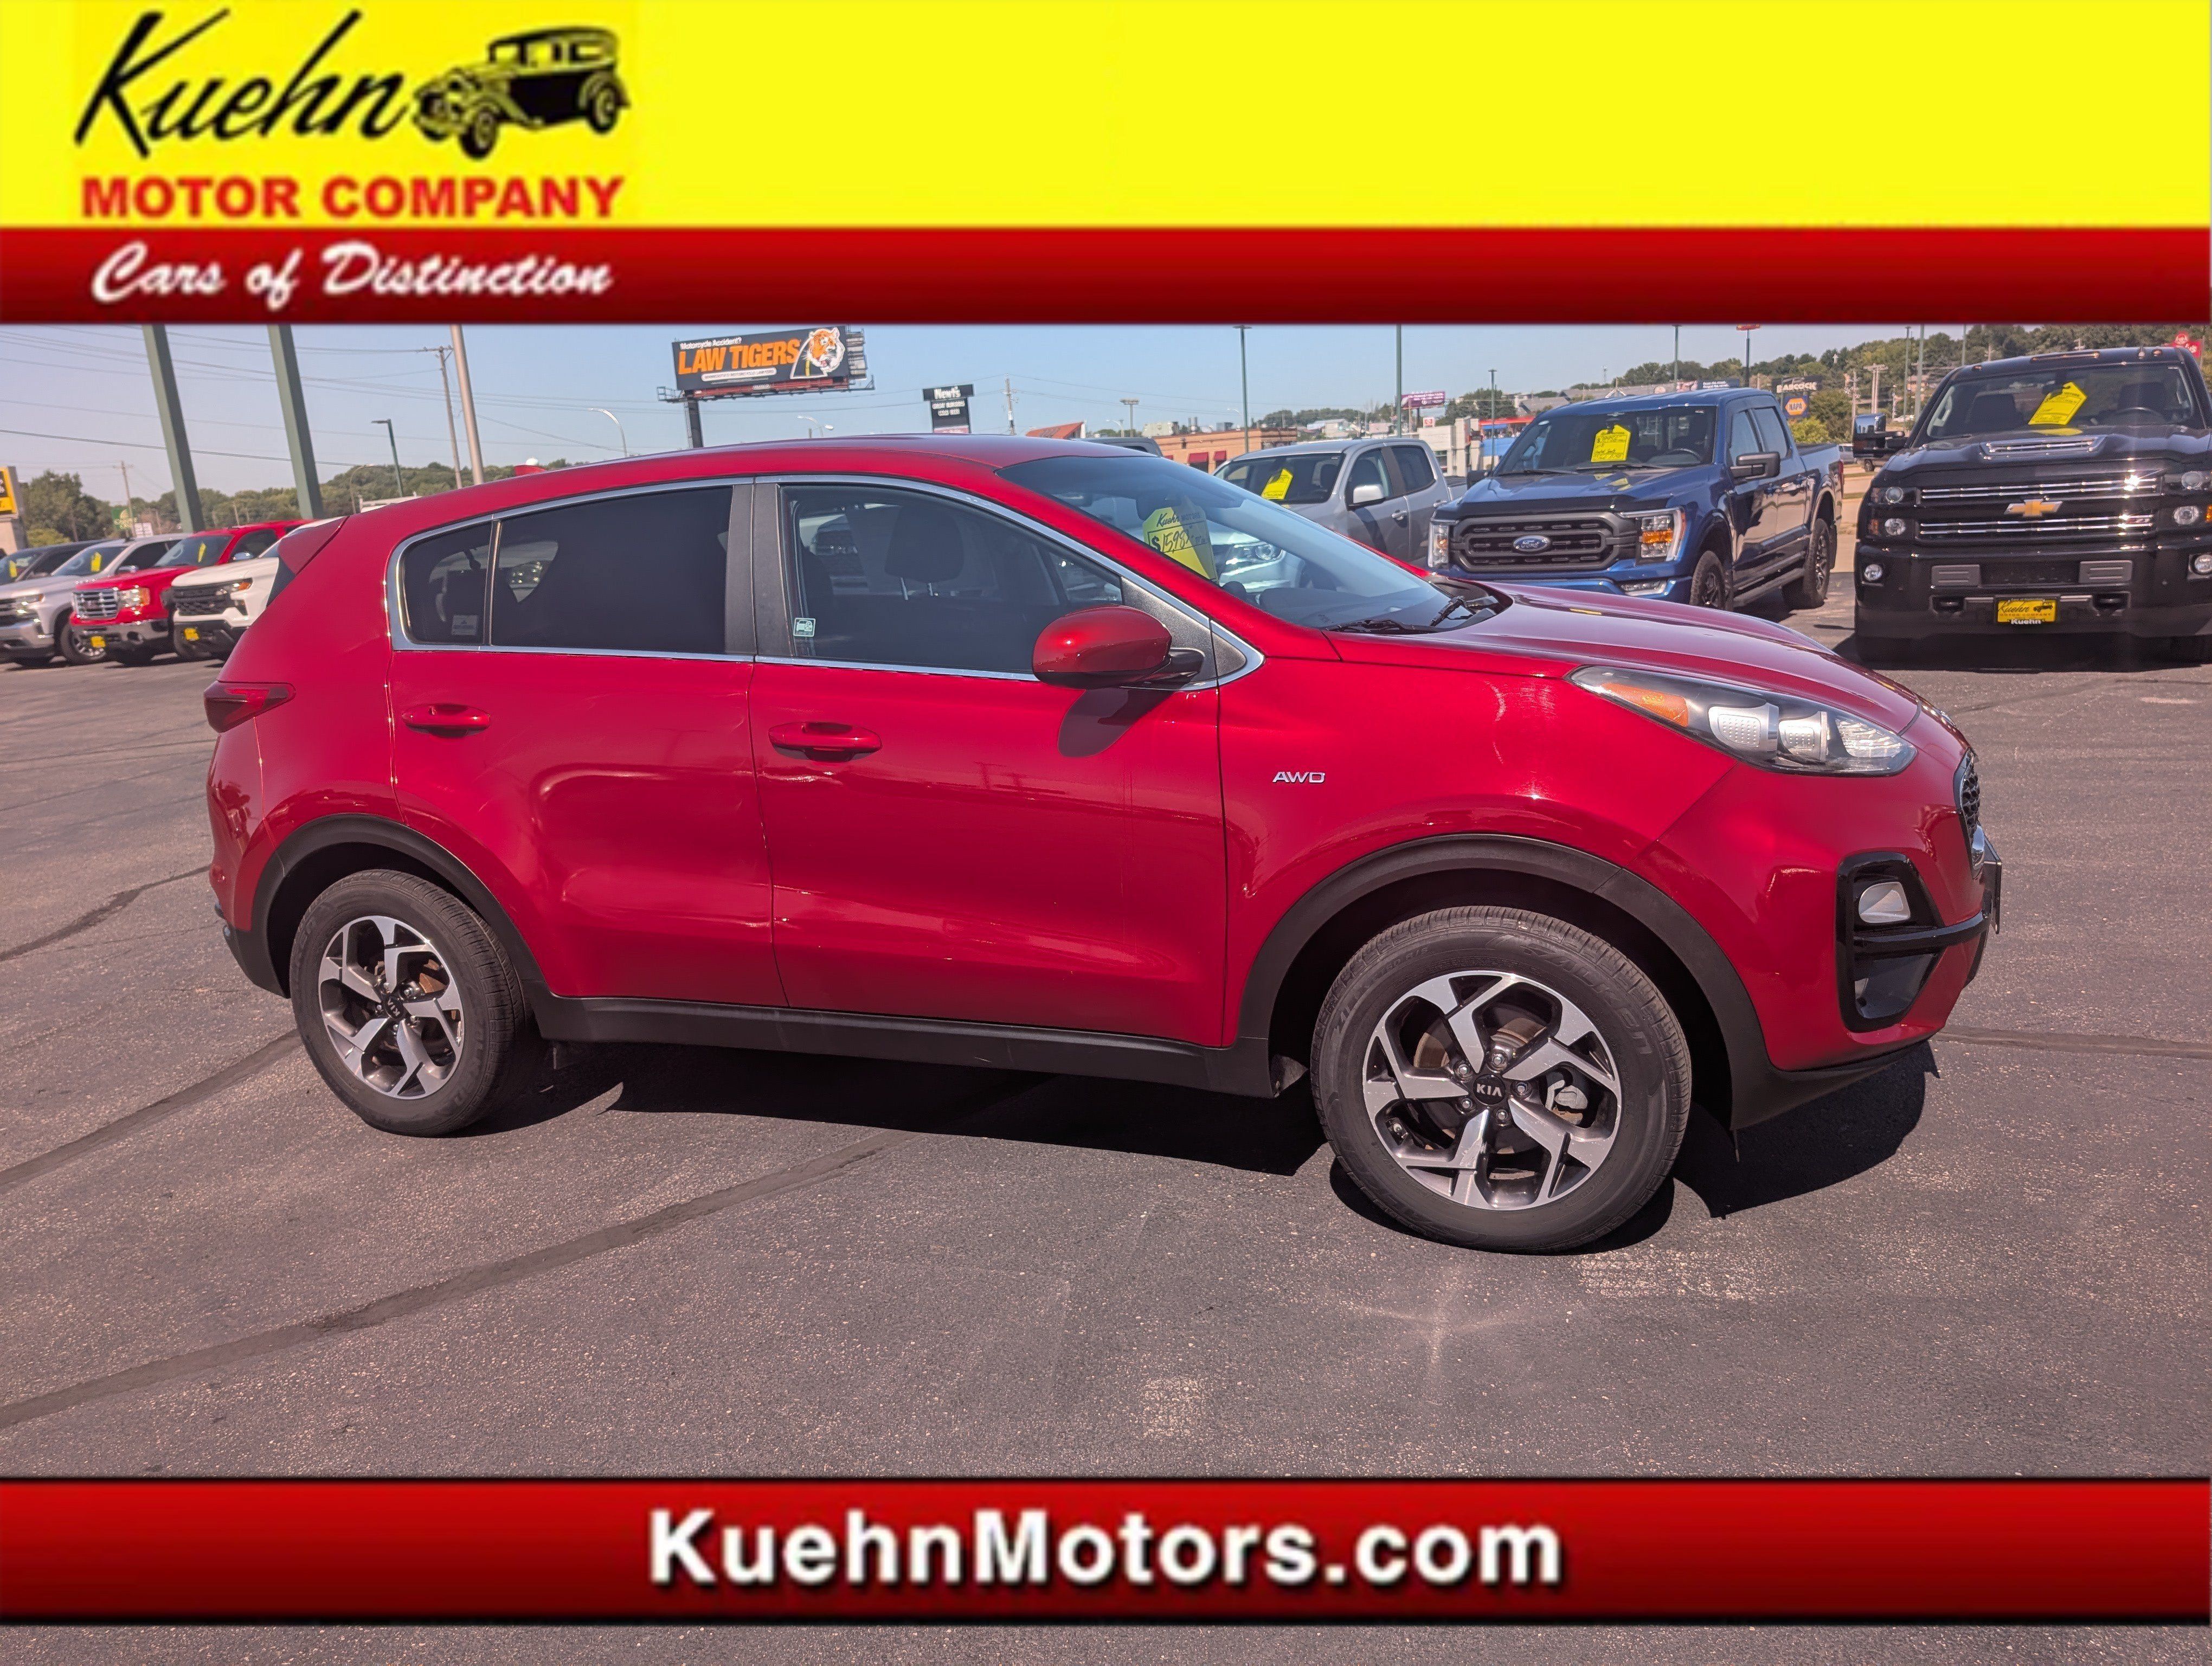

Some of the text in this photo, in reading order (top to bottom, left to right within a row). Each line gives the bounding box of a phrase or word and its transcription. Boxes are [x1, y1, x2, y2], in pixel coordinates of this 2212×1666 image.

[678, 338, 801, 374] LAW TIGERS
[1272, 771, 1326, 783] AWD
[1476, 1083, 1502, 1097] KIA
